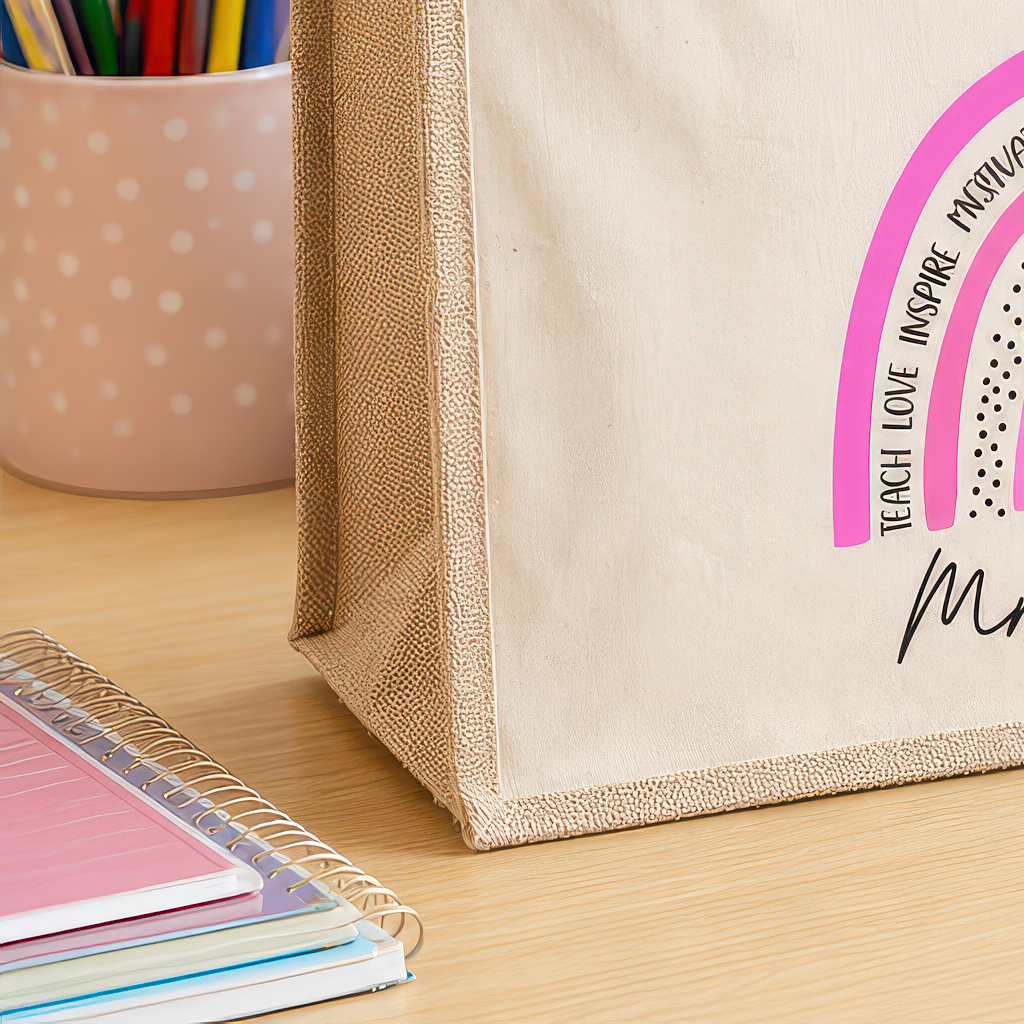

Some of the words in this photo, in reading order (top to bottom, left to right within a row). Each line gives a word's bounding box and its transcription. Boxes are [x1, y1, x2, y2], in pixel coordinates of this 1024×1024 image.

[898, 241, 961, 346] INSPIRE
[881, 362, 919, 430] LOVE
[879, 448, 912, 537] TEACH
